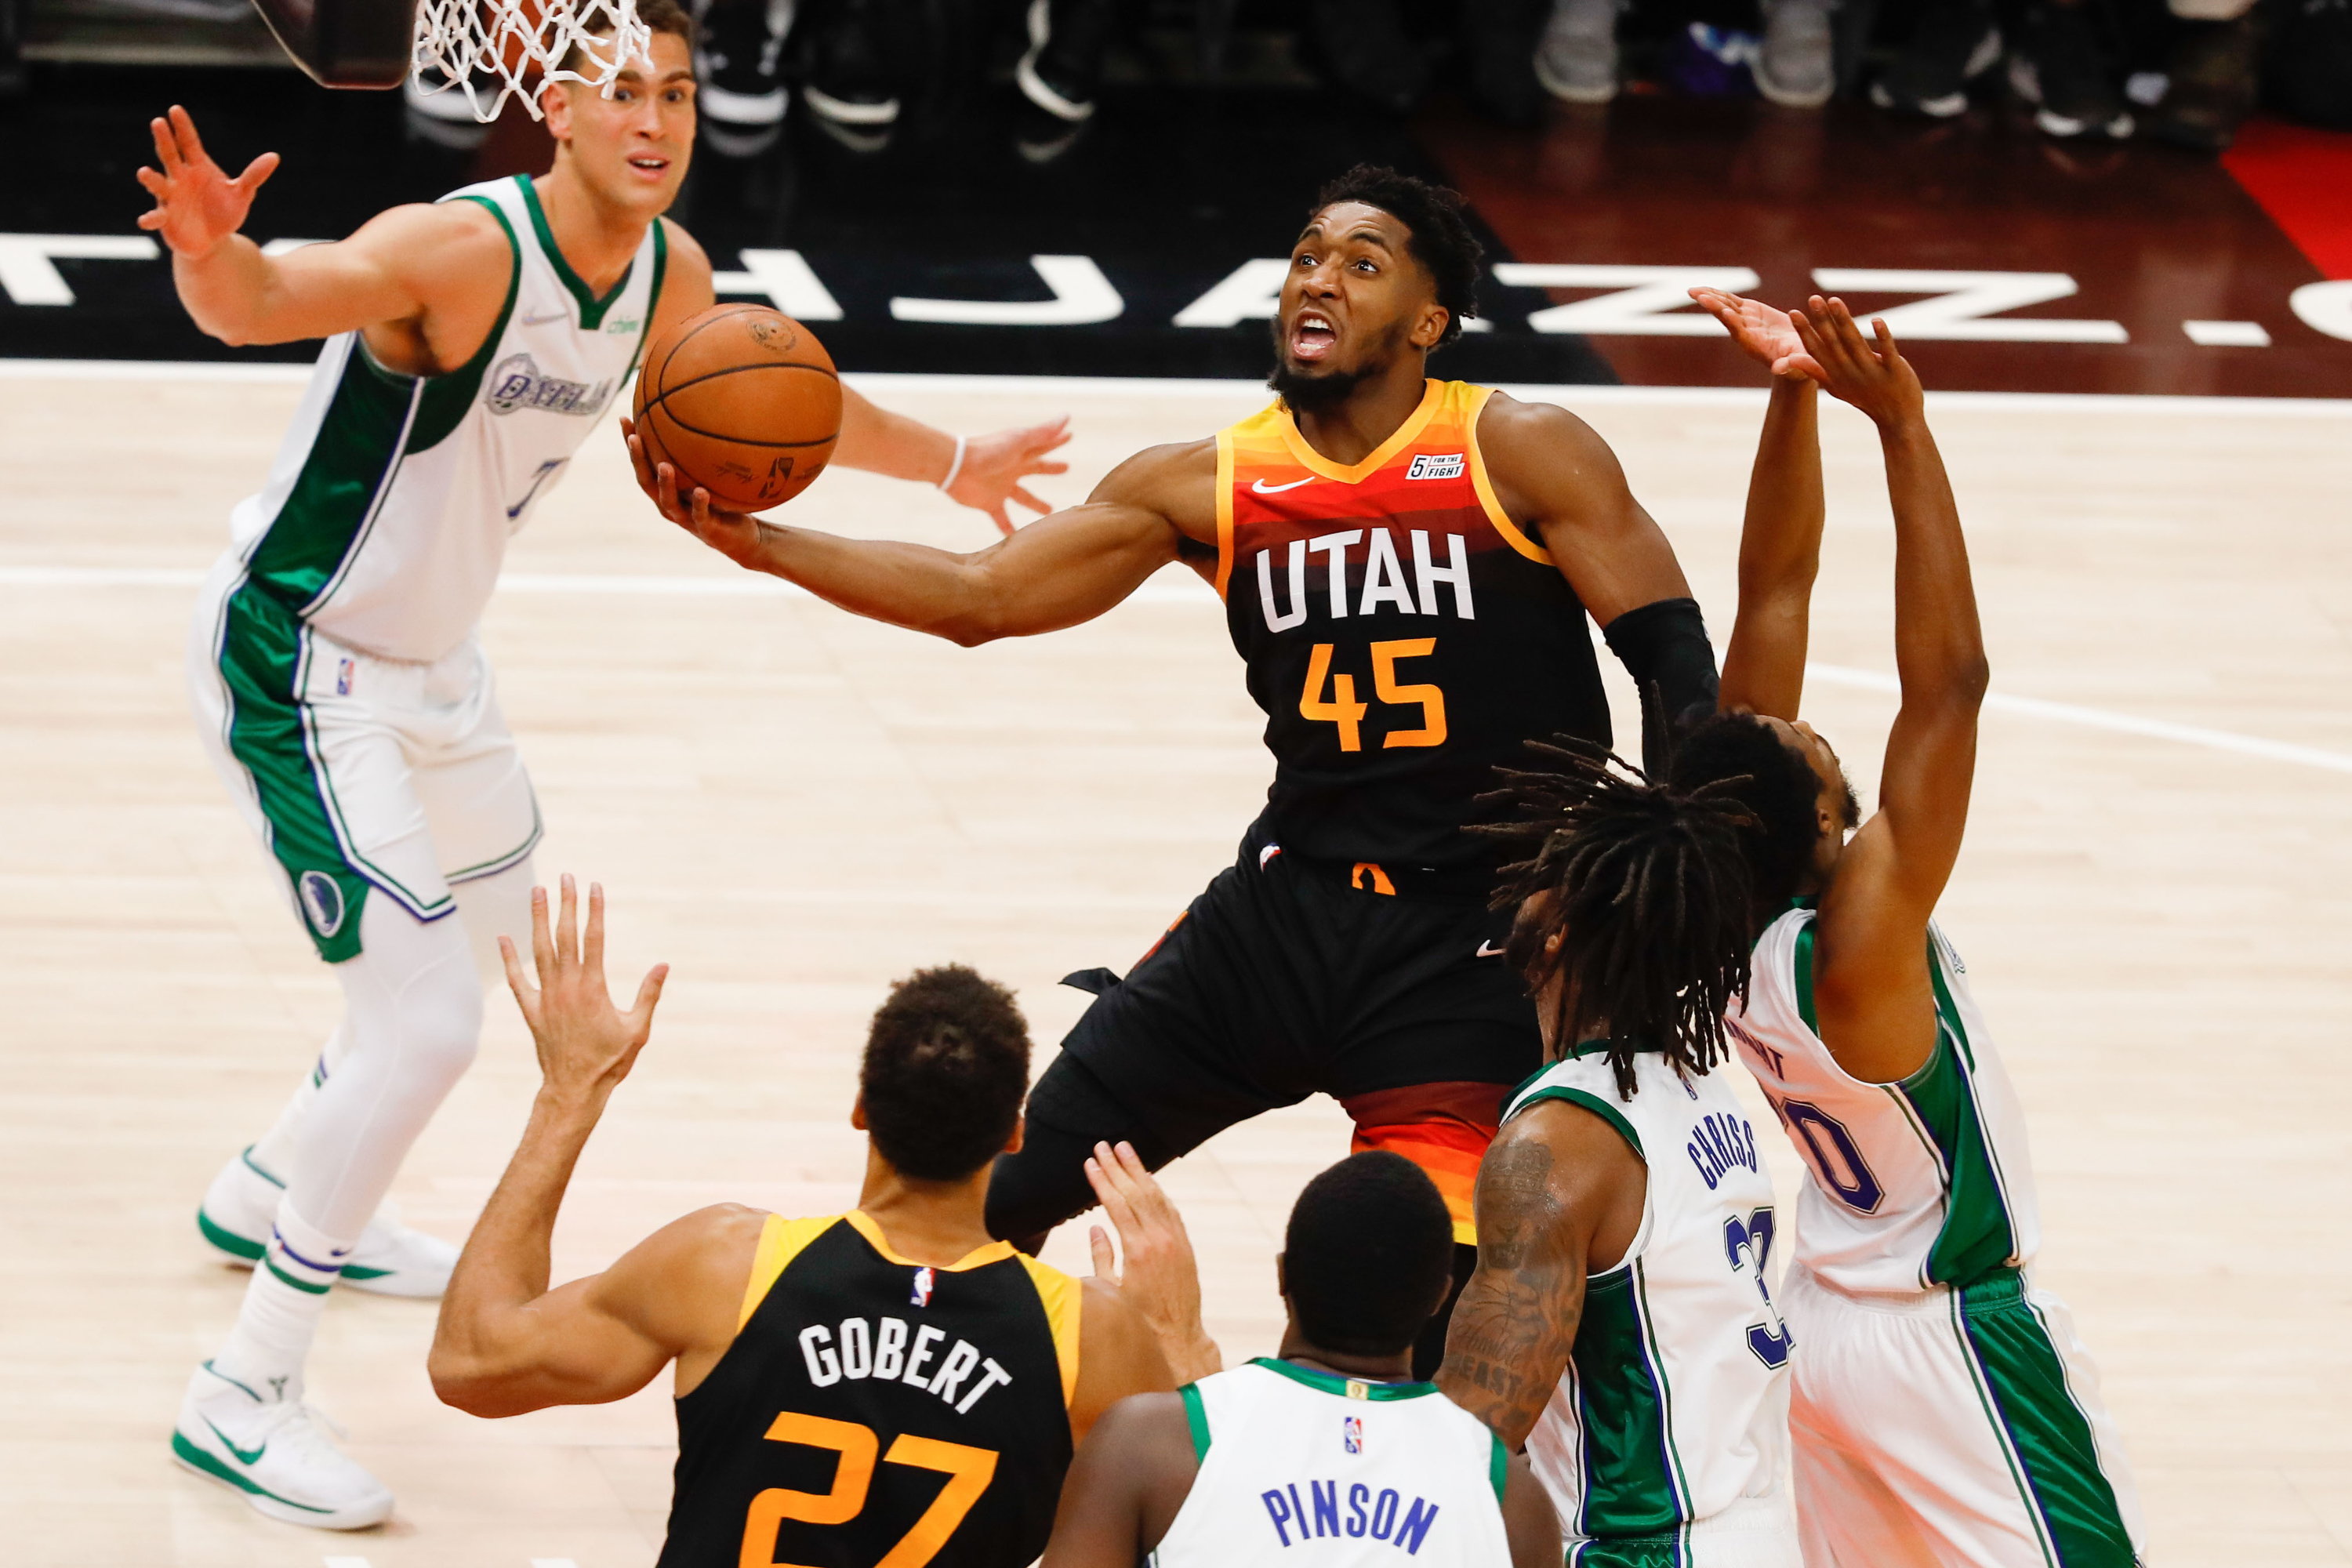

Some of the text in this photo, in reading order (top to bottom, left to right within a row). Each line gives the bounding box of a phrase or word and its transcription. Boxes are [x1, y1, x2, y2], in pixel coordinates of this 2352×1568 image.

[1411, 457, 1427, 477] 5
[1428, 466, 1461, 477] FIGHT
[1256, 527, 1475, 633] UTAH
[1299, 637, 1448, 753] 45
[1687, 1112, 1758, 1191] CHRISS
[798, 1316, 1014, 1415] GOBERT
[738, 1410, 1000, 1568] 27
[1261, 1479, 1439, 1555] PINSON
